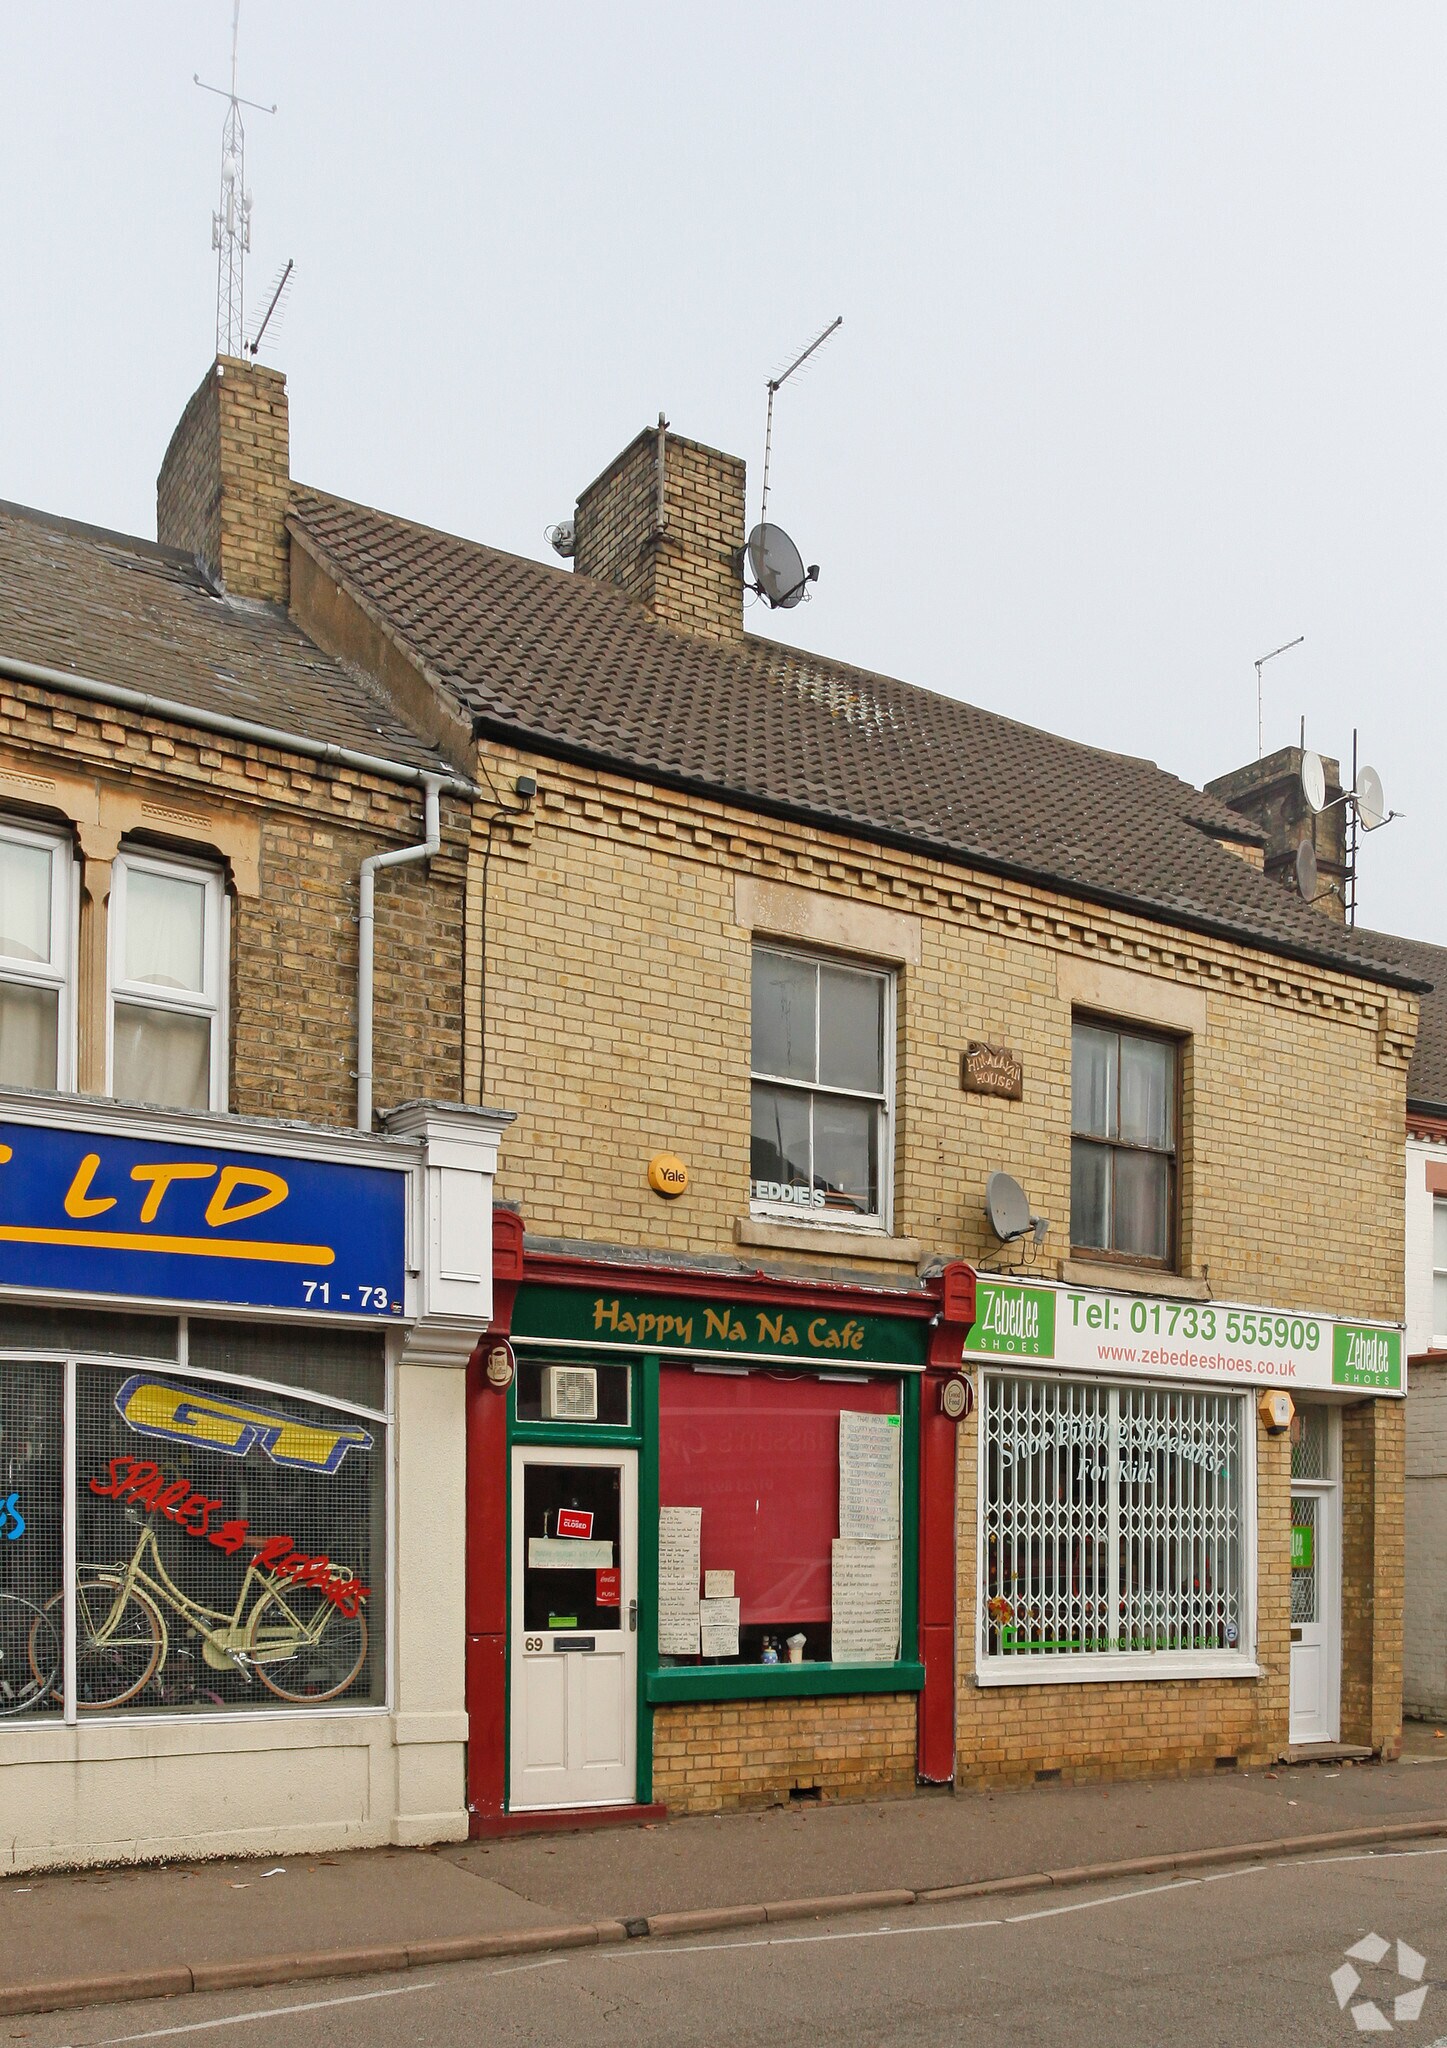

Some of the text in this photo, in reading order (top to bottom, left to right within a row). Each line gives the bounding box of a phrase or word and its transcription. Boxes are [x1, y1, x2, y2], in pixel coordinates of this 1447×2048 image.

[974, 1073, 1015, 1091] HOUSE
[64, 1152, 290, 1227] LTD
[660, 1167, 687, 1184] Yale
[303, 1281, 330, 1304] 71
[358, 1286, 388, 1309] 73
[592, 1297, 866, 1350] Happy Na Na Café
[982, 1290, 1040, 1340] Zebedee
[1067, 1293, 1321, 1352] Tel: 01733 555909
[981, 1338, 1041, 1355] SHOES
[1097, 1343, 1297, 1377] www.zebedeeshoes.co.uk
[1345, 1331, 1389, 1374] Zebedee
[1344, 1372, 1391, 1386] SHOES
[115, 1375, 373, 1473] GT
[1076, 1458, 1157, 1484] For Kids
[89, 1456, 223, 1537] SPARES
[563, 1521, 587, 1530] CLOSED
[525, 1637, 544, 1652] 69
